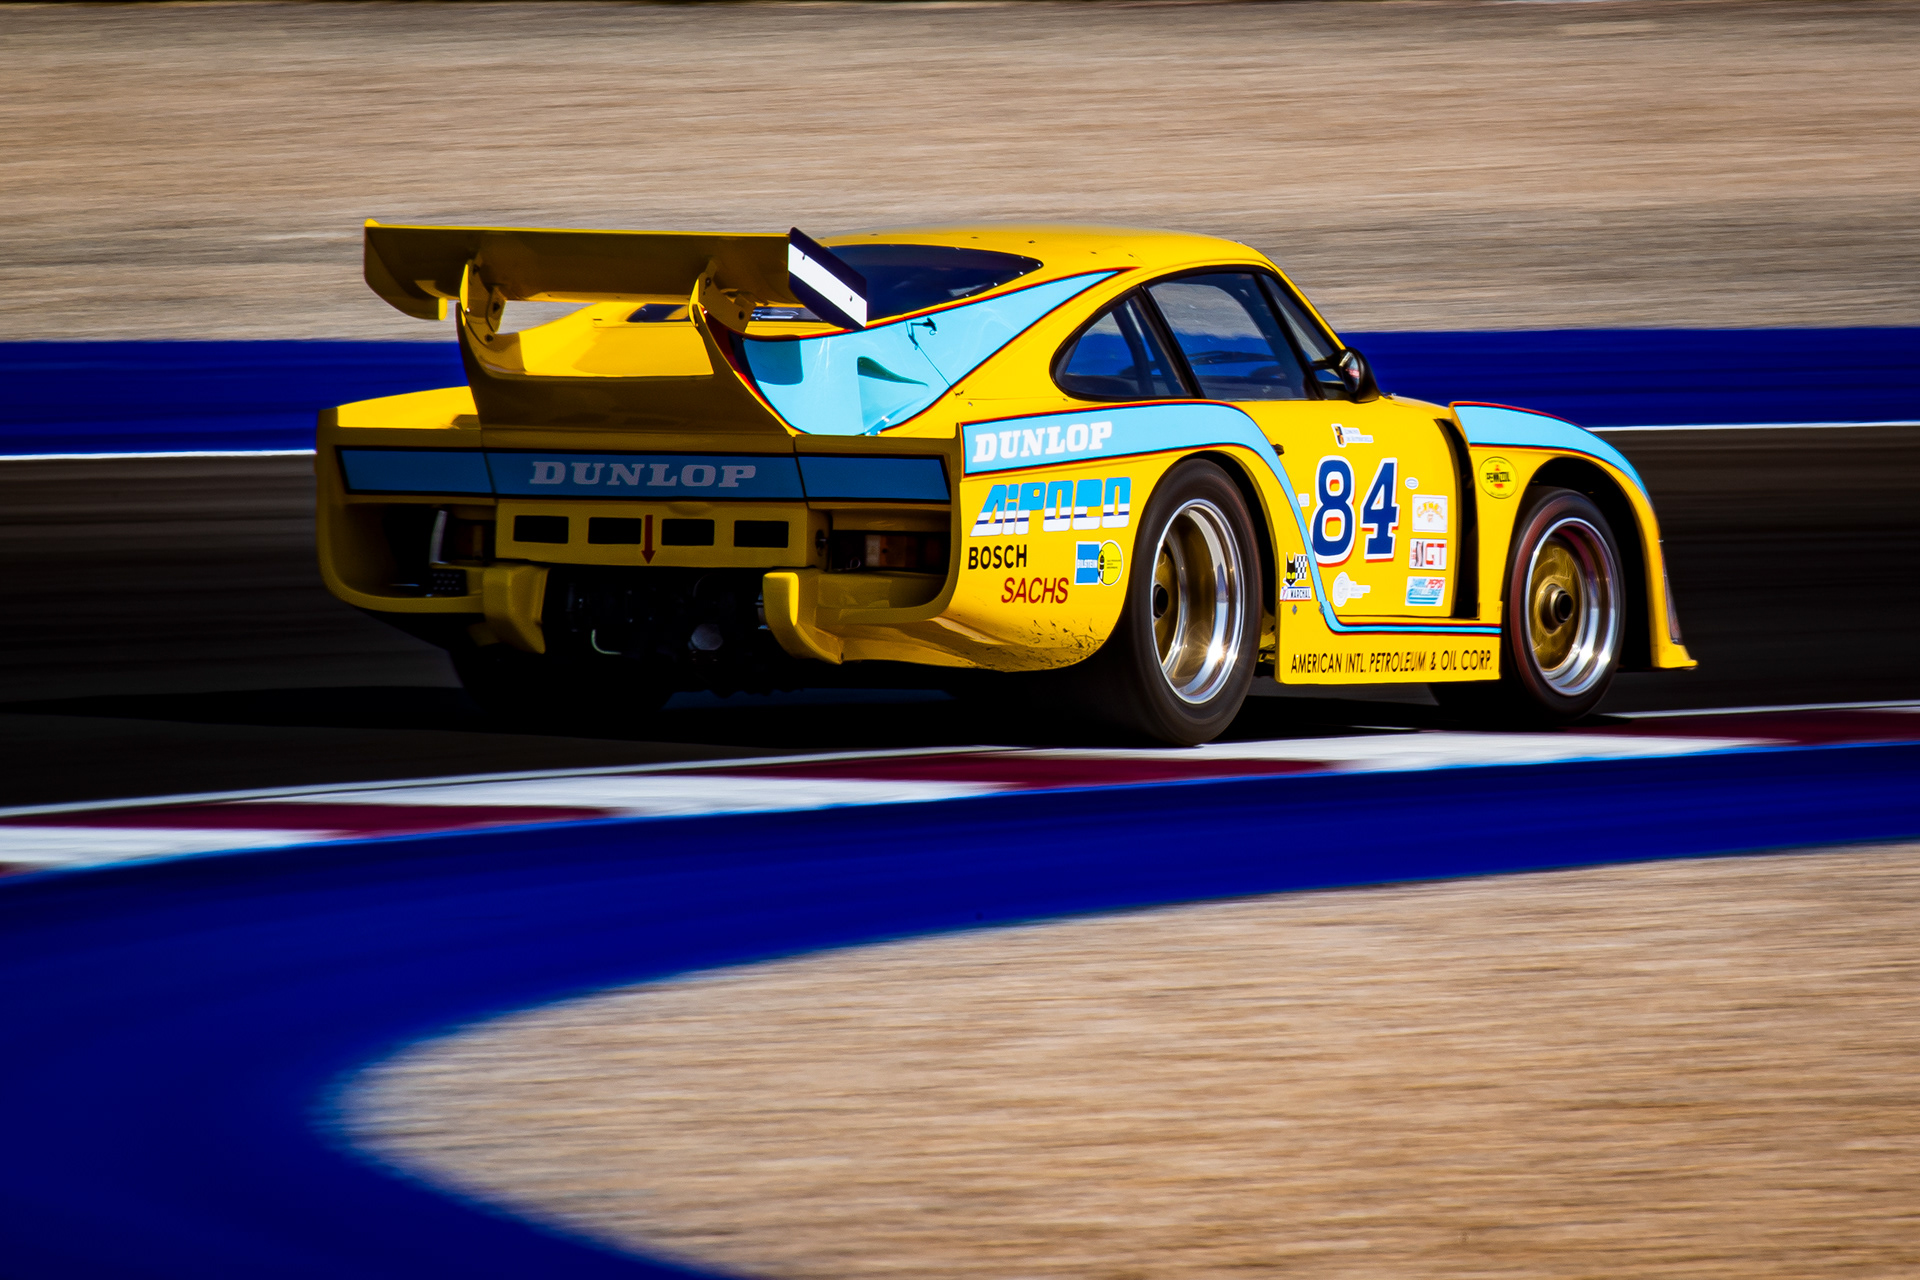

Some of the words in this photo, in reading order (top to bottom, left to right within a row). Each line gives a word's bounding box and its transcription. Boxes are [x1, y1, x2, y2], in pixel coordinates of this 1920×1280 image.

[972, 421, 1112, 462] DUNLOP
[529, 461, 757, 487] DUNLOP
[1311, 456, 1398, 563] 84
[968, 544, 1028, 570] BOSCH
[1425, 543, 1447, 565] GT
[1001, 577, 1069, 604] SACHS
[1291, 652, 1343, 674] AMERICAN
[1369, 651, 1427, 673] PETROLEUM
[1430, 651, 1437, 670] &
[1441, 649, 1457, 671] OIL
[1460, 649, 1493, 671] CORP.
